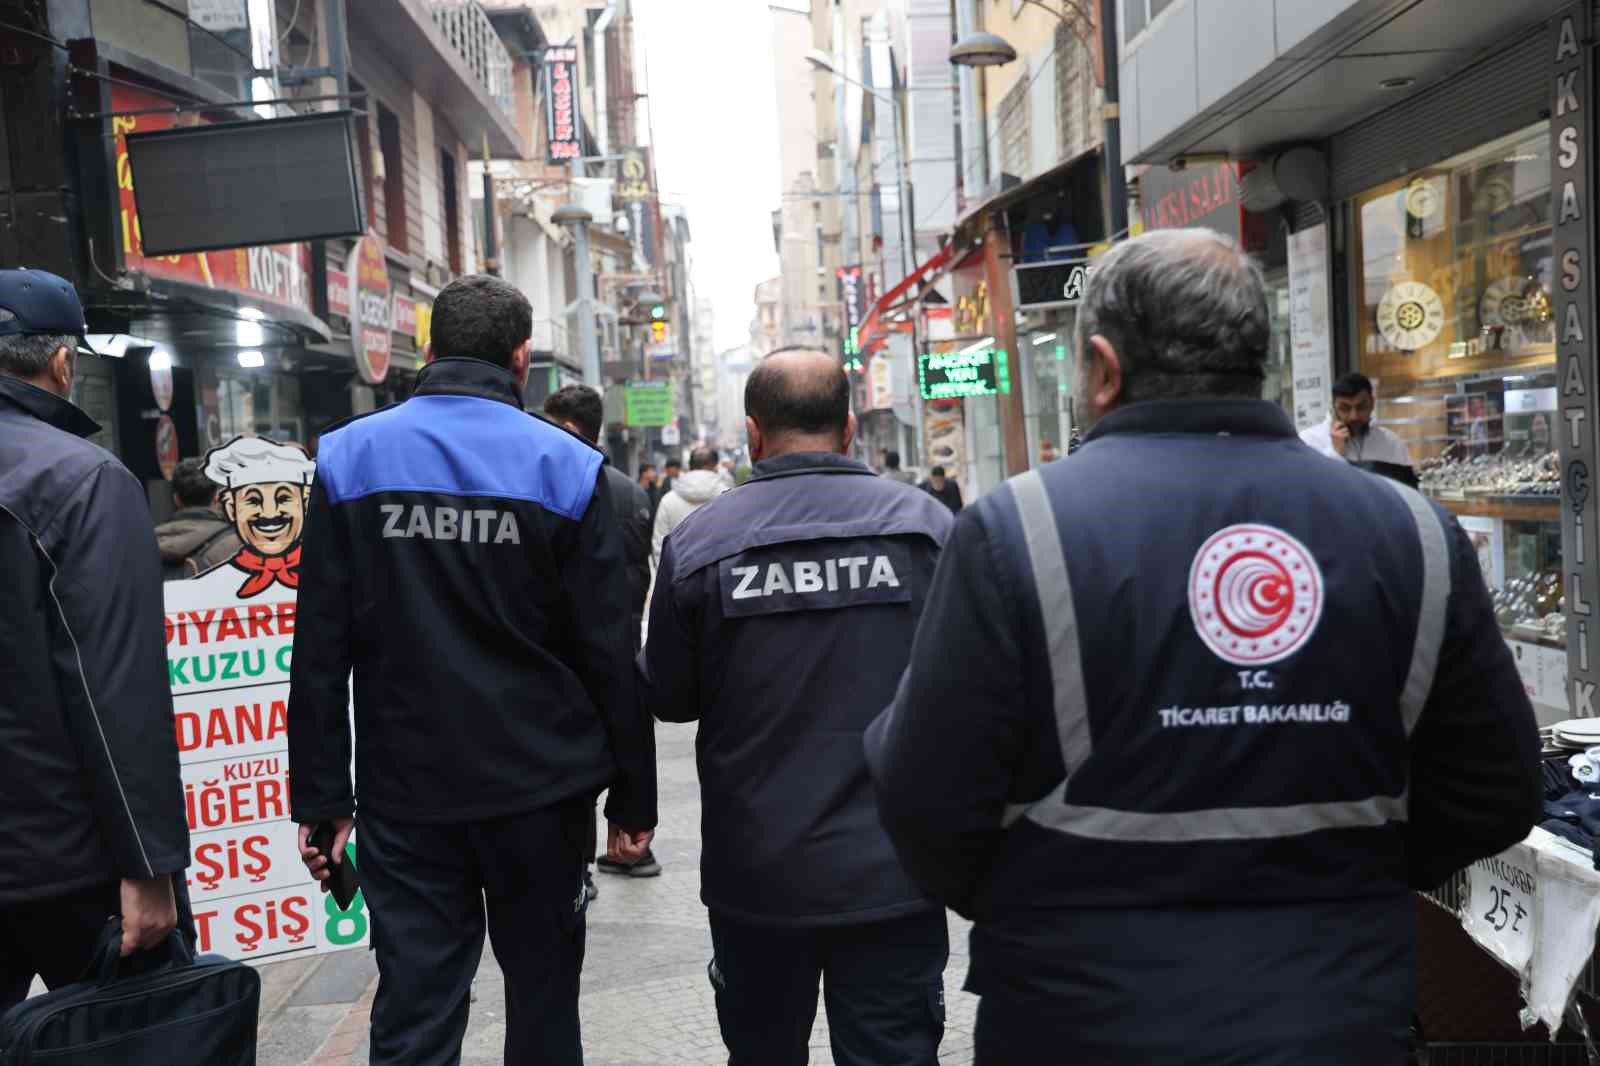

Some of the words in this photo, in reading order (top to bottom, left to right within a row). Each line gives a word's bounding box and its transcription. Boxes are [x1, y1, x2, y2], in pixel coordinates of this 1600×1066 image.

[1555, 17, 1581, 226] AKSA
[380, 504, 521, 545] ZABITA
[731, 555, 900, 600] ZABITA
[168, 648, 266, 686] KUZU
[1237, 671, 1274, 689] T.C.
[175, 700, 289, 752] DANA
[1158, 705, 1241, 728] TİCARET
[1243, 700, 1351, 723] BAKANLIĞI
[223, 757, 280, 782] KUZU
[194, 835, 272, 891] ŞİŞ
[233, 896, 310, 951] ŞİŞ
